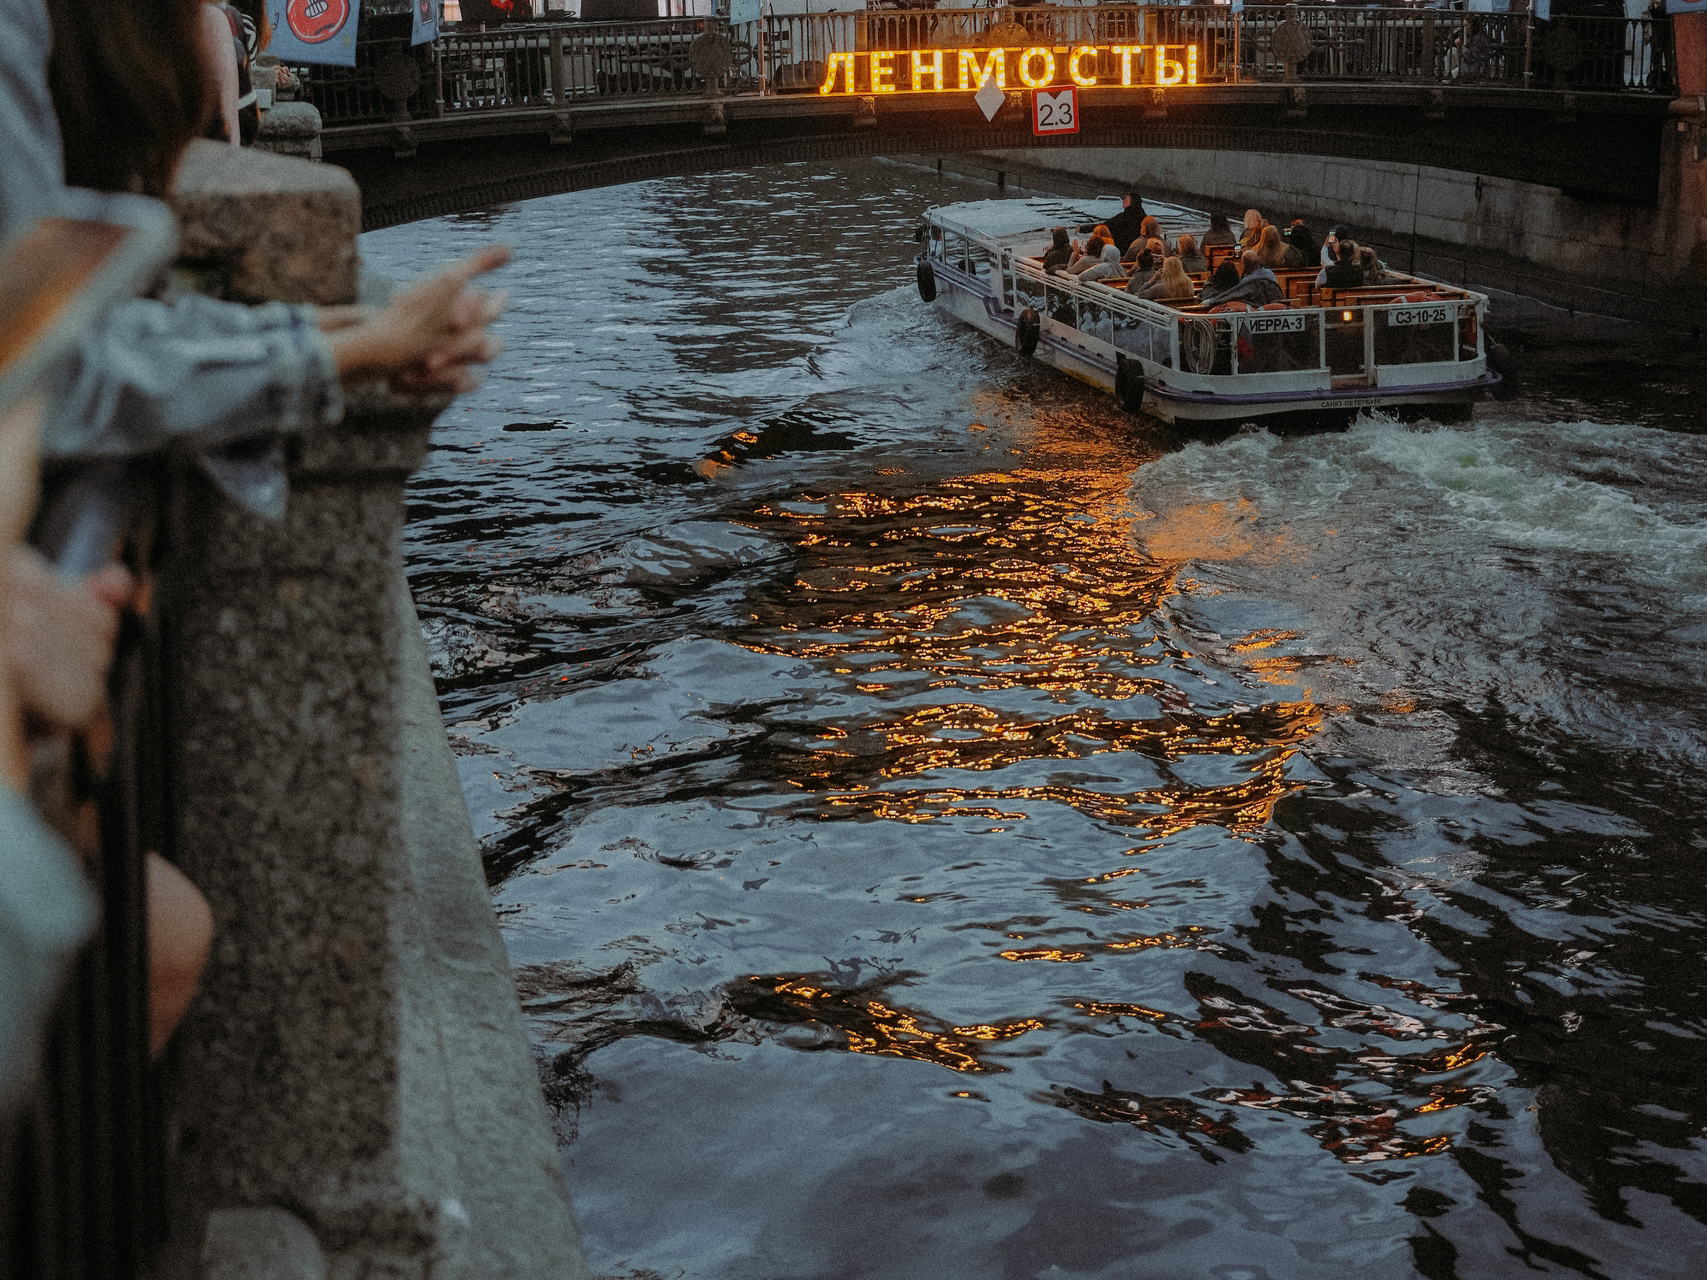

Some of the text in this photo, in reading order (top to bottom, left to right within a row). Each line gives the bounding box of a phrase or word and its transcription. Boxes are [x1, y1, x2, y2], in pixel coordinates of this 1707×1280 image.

[819, 45, 1197, 94] ЛЕНМОСТЫ
[1040, 103, 1072, 126] 2.3
[1241, 317, 1303, 332] ИЕРРА-3
